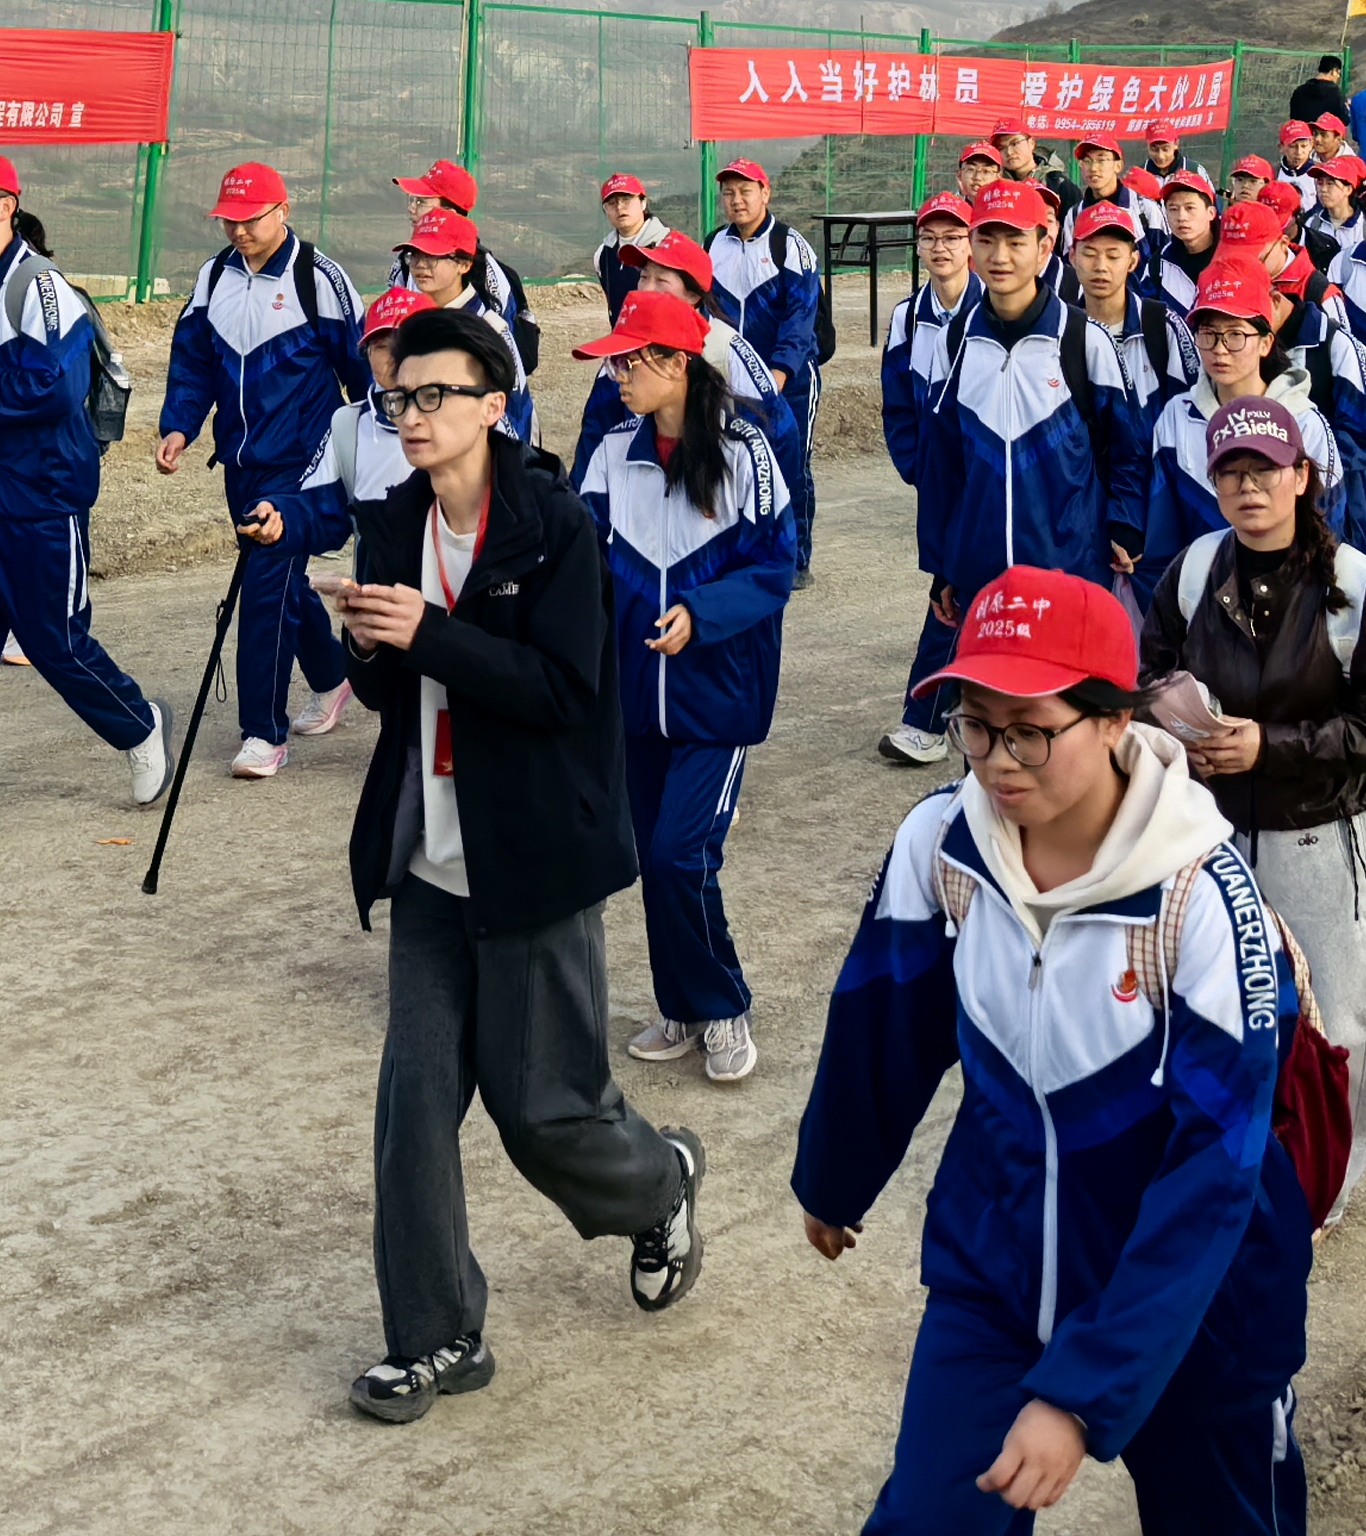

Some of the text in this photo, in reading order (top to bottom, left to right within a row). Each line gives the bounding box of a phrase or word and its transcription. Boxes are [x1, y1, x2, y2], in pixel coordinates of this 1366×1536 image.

[1230, 419, 1286, 443] Bietta
[488, 582, 520, 597] CAME
[977, 619, 1032, 639] 2025级
[1204, 844, 1277, 1031] YUANERZHONG
